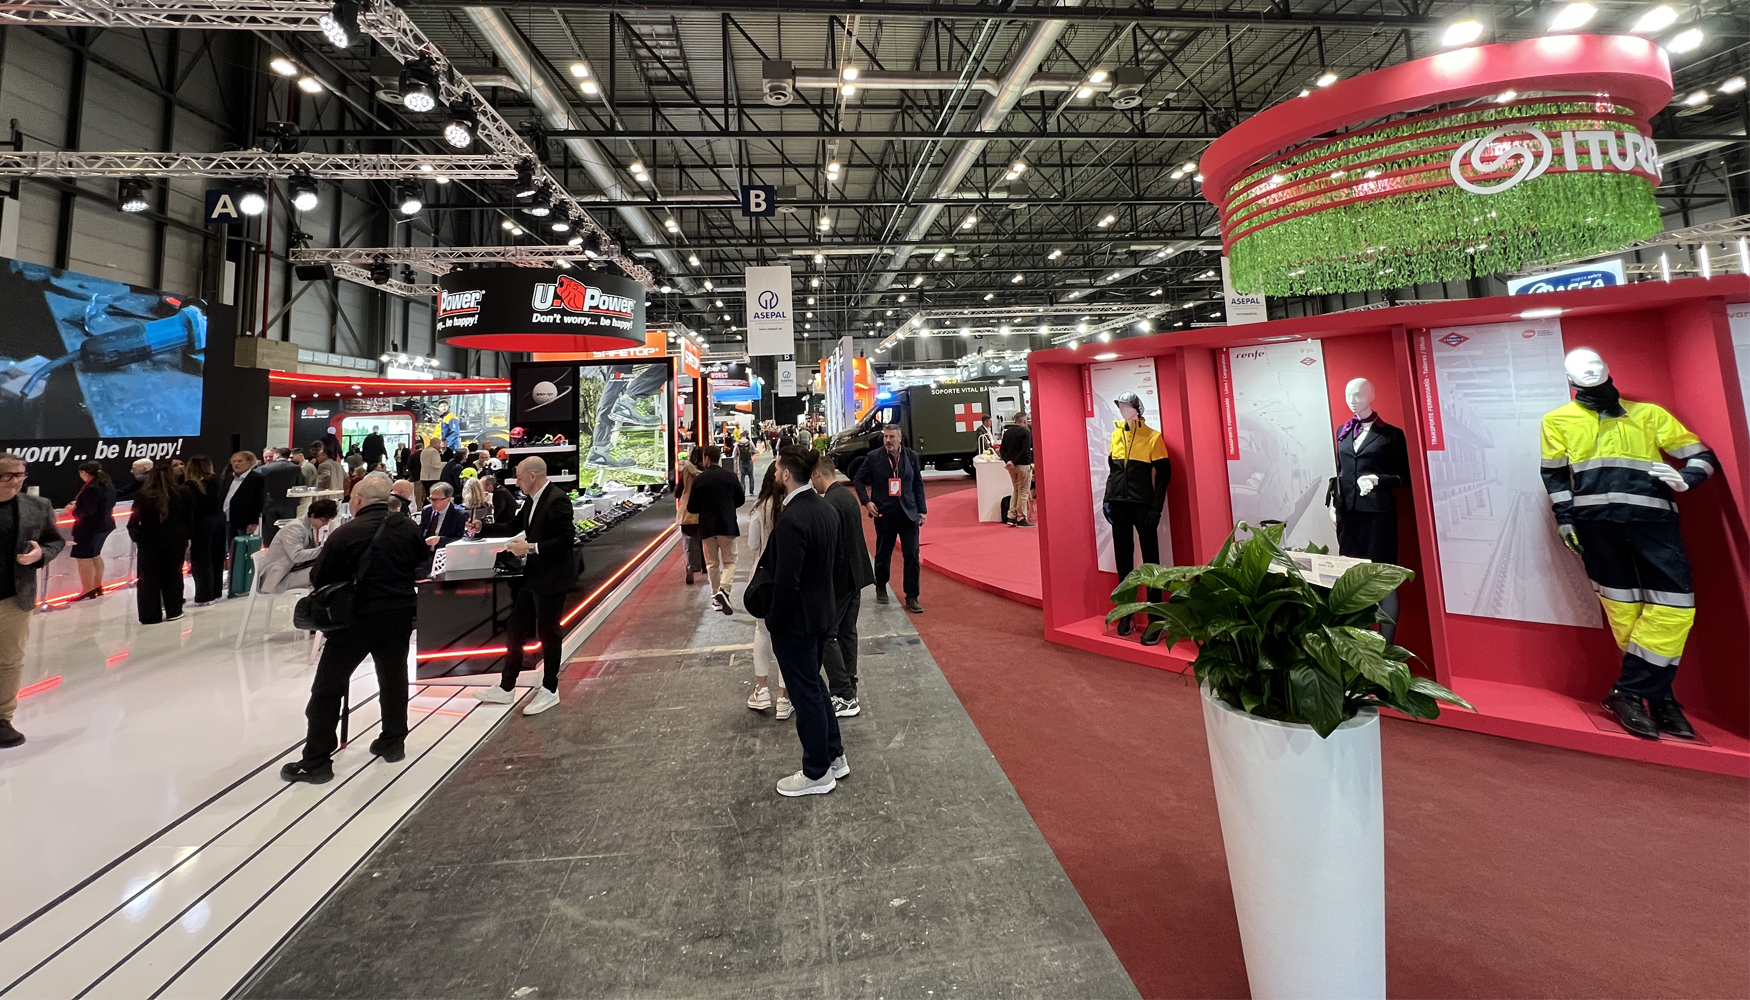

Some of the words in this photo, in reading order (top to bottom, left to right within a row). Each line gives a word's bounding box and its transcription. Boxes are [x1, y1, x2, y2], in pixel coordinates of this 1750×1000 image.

[211, 194, 238, 218] A
[750, 190, 767, 212] B
[1587, 273, 1602, 281] safety
[1231, 297, 1261, 305] ASEPAL
[445, 317, 453, 327] be
[453, 314, 479, 328] happy!
[532, 313, 561, 323] Don't
[600, 316, 611, 326] be
[611, 318, 633, 330] happy!
[753, 311, 787, 319] ASEPAL
[1236, 350, 1265, 360] renfe
[1430, 412, 1438, 446] TRANSPORTE
[95, 441, 119, 460] be
[125, 439, 183, 461] happy!
